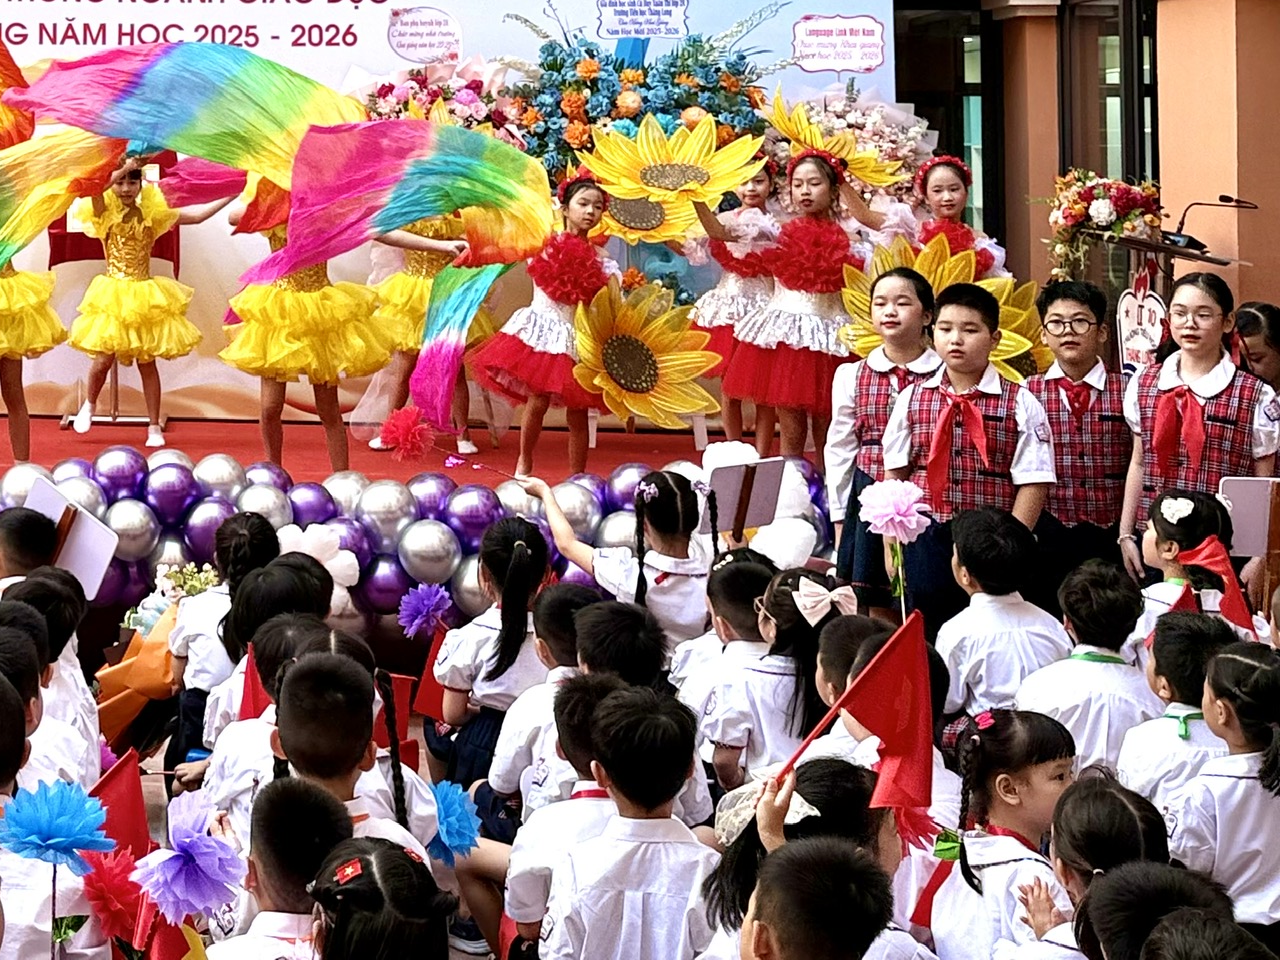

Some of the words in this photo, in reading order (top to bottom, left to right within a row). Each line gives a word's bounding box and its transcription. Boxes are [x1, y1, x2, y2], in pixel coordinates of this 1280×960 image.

[39, 17, 106, 45] NĂM
[194, 24, 259, 47] 2025
[291, 24, 358, 47] 2026
